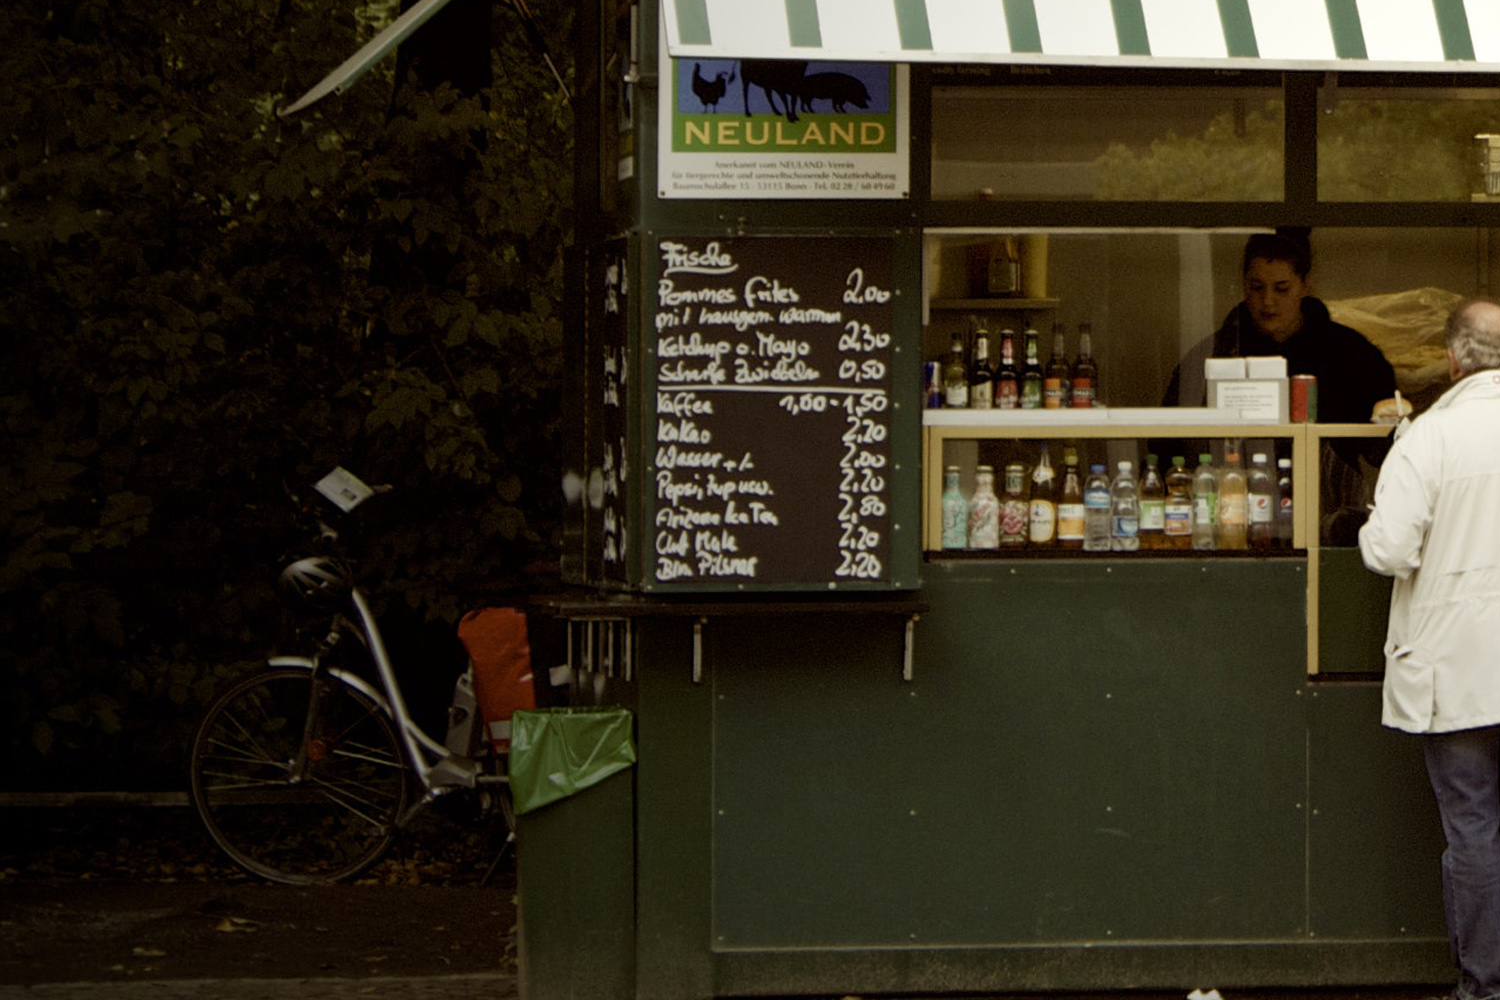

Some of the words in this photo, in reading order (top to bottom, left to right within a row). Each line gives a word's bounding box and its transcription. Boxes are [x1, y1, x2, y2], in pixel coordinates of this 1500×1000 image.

[684, 121, 886, 145] NEULAND
[685, 171, 733, 181] tiergerechte
[736, 171, 753, 180] und
[755, 171, 829, 180] umweltschonende
[832, 171, 897, 181] Nutztierhaltung
[715, 159, 757, 169] Anerkannt
[659, 241, 732, 268] Frische
[657, 279, 737, 306] Pommes
[655, 307, 691, 333] mit
[657, 331, 731, 366] Ketchup
[756, 331, 811, 363] Mayo
[734, 357, 820, 384] Zwiebeln
[838, 359, 886, 383] 0,50
[656, 391, 713, 417] Kaffee
[655, 444, 723, 470] Wasser
[655, 505, 721, 530] Arizona
[695, 529, 738, 553] Mate
[695, 550, 758, 577] Pilsner
